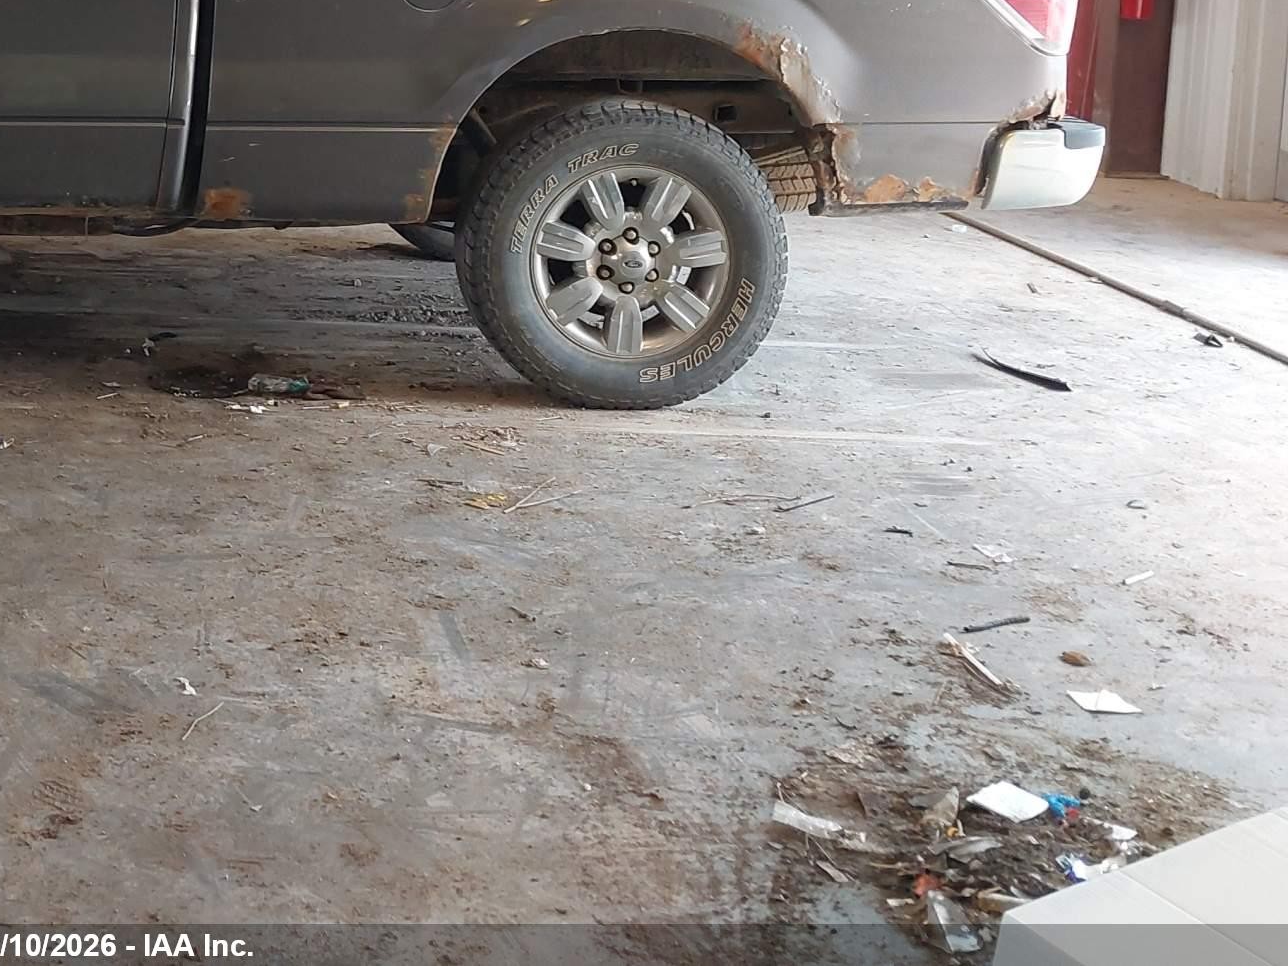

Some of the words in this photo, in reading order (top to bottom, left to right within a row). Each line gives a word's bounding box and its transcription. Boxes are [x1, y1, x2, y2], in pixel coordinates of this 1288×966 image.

[510, 174, 559, 254] TERRA
[567, 143, 640, 173] TRAC
[639, 277, 756, 383] HERCULES
